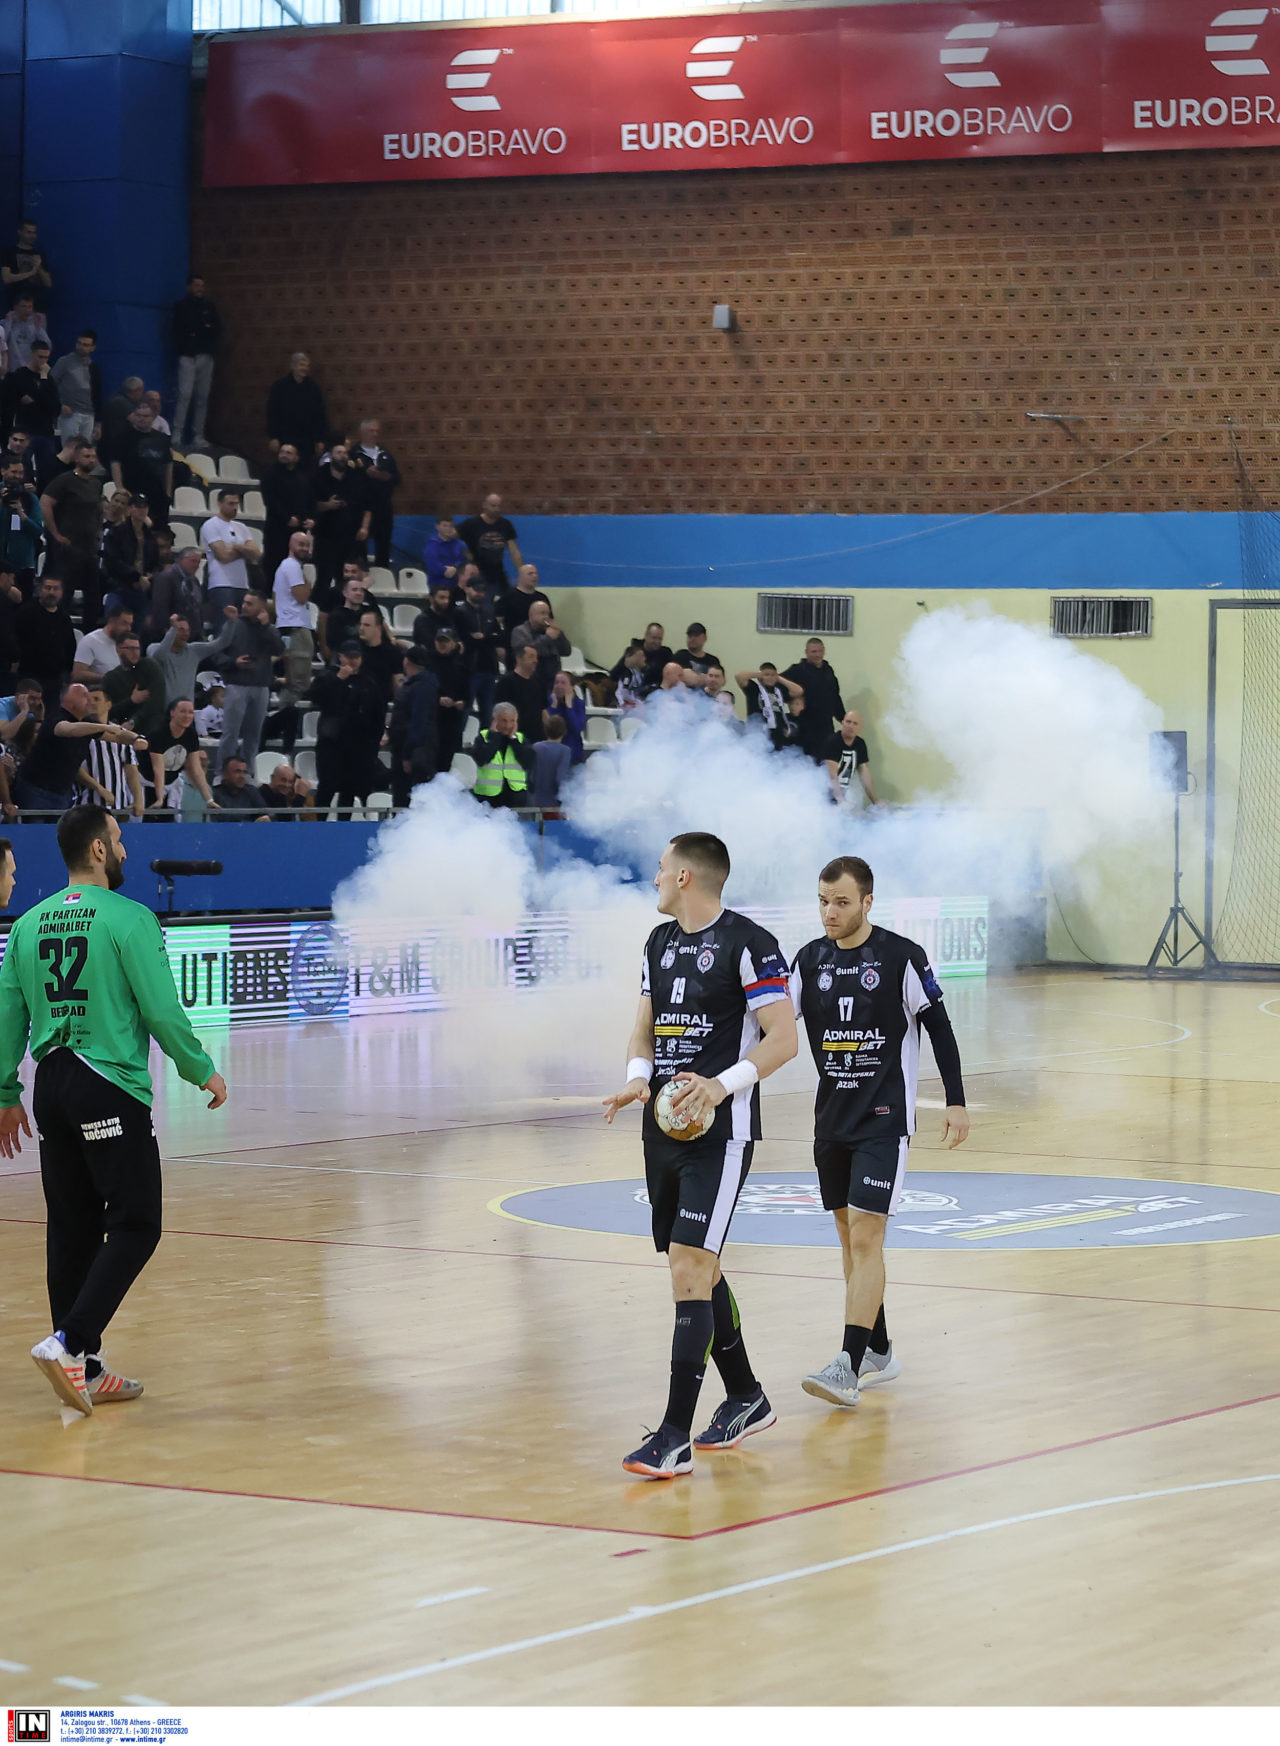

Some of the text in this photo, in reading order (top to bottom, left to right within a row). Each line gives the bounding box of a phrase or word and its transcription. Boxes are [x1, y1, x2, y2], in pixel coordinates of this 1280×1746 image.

[870, 104, 1073, 140] EUROBRAVO
[620, 116, 815, 151] EUROBRAVO
[383, 127, 567, 160] EUROBRAVO
[40, 908, 96, 922] RK PARTIZAN
[38, 921, 91, 935] ADMIRALBET
[38, 936, 88, 1002] 32
[670, 977, 686, 1004] 19
[838, 996, 854, 1021] 17
[655, 1013, 714, 1027] ADMIRAL
[683, 1027, 713, 1037] BET
[823, 1028, 886, 1041] ADMIRAL
[858, 1041, 886, 1051] BET
[871, 1179, 891, 1190] unit
[686, 1212, 707, 1223] unit
[893, 1194, 1171, 1234] ADMIRAL
